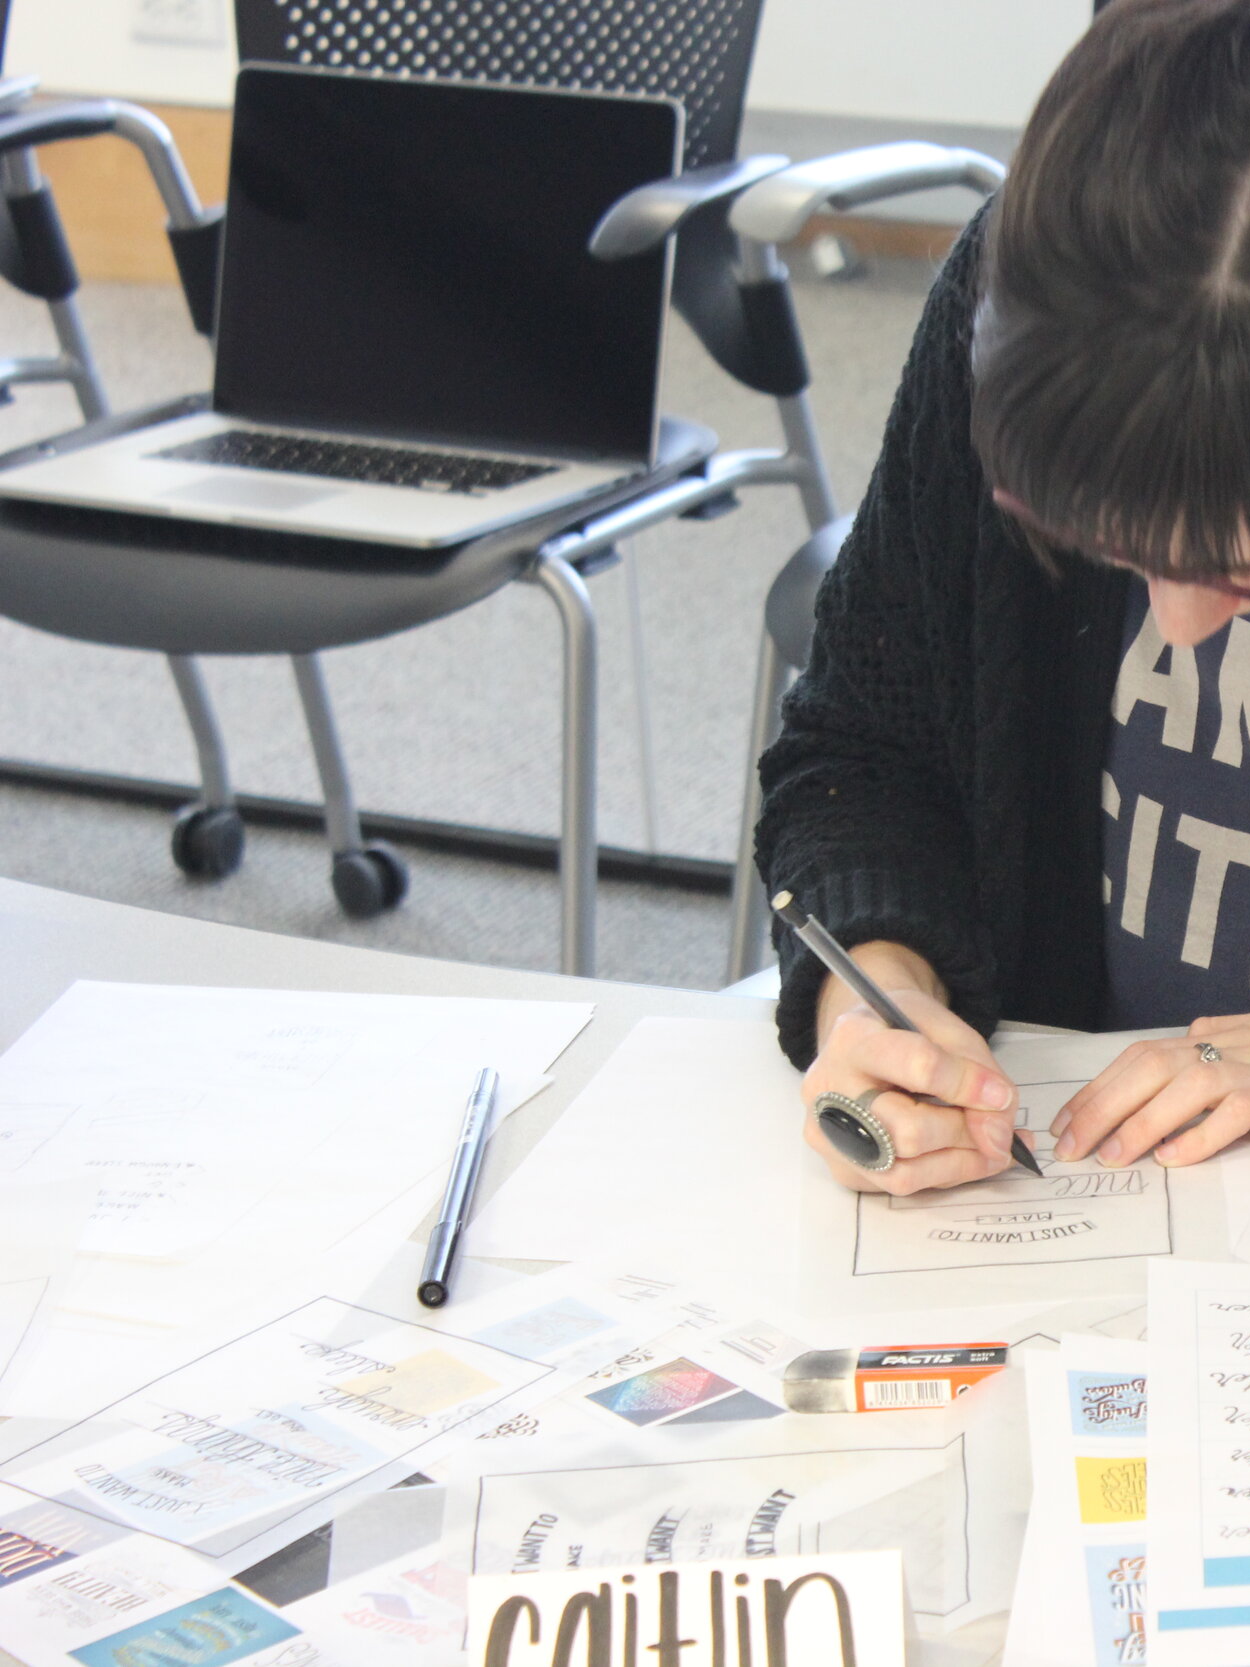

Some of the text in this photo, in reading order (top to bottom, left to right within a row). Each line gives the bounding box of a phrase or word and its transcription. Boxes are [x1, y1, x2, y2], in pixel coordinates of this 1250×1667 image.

[938, 1230, 960, 1241] TO
[971, 1230, 1024, 1244] WANT
[1030, 1223, 1080, 1241] JUST
[881, 1355, 956, 1366] FACTIS
[484, 1570, 857, 1667] caitlin
